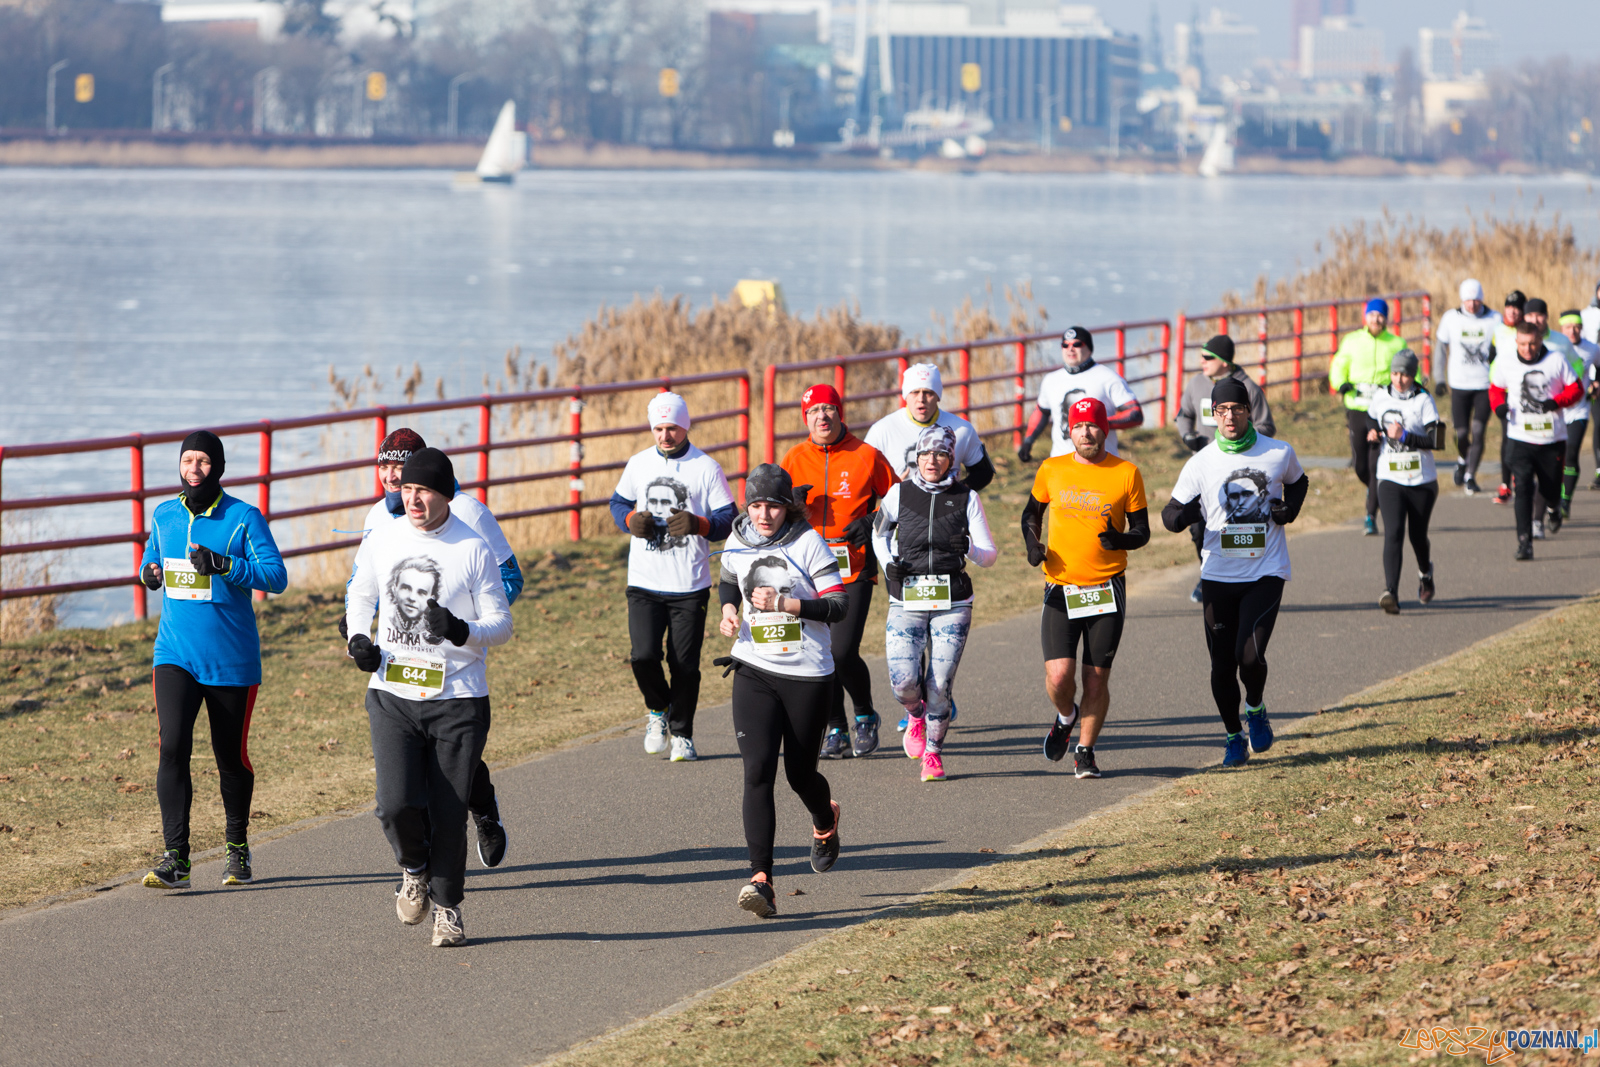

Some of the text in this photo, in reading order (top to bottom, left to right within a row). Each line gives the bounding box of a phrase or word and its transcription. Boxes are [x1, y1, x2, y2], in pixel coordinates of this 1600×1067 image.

[1059, 490, 1103, 505] Winter
[1101, 503, 1112, 516] 2
[1233, 534, 1253, 545] 889
[174, 572, 196, 584] 739
[916, 586, 937, 597] 354
[1079, 591, 1100, 604] 356
[387, 627, 421, 646] ZAPORA
[763, 625, 786, 638] 225
[402, 667, 427, 682] 644
